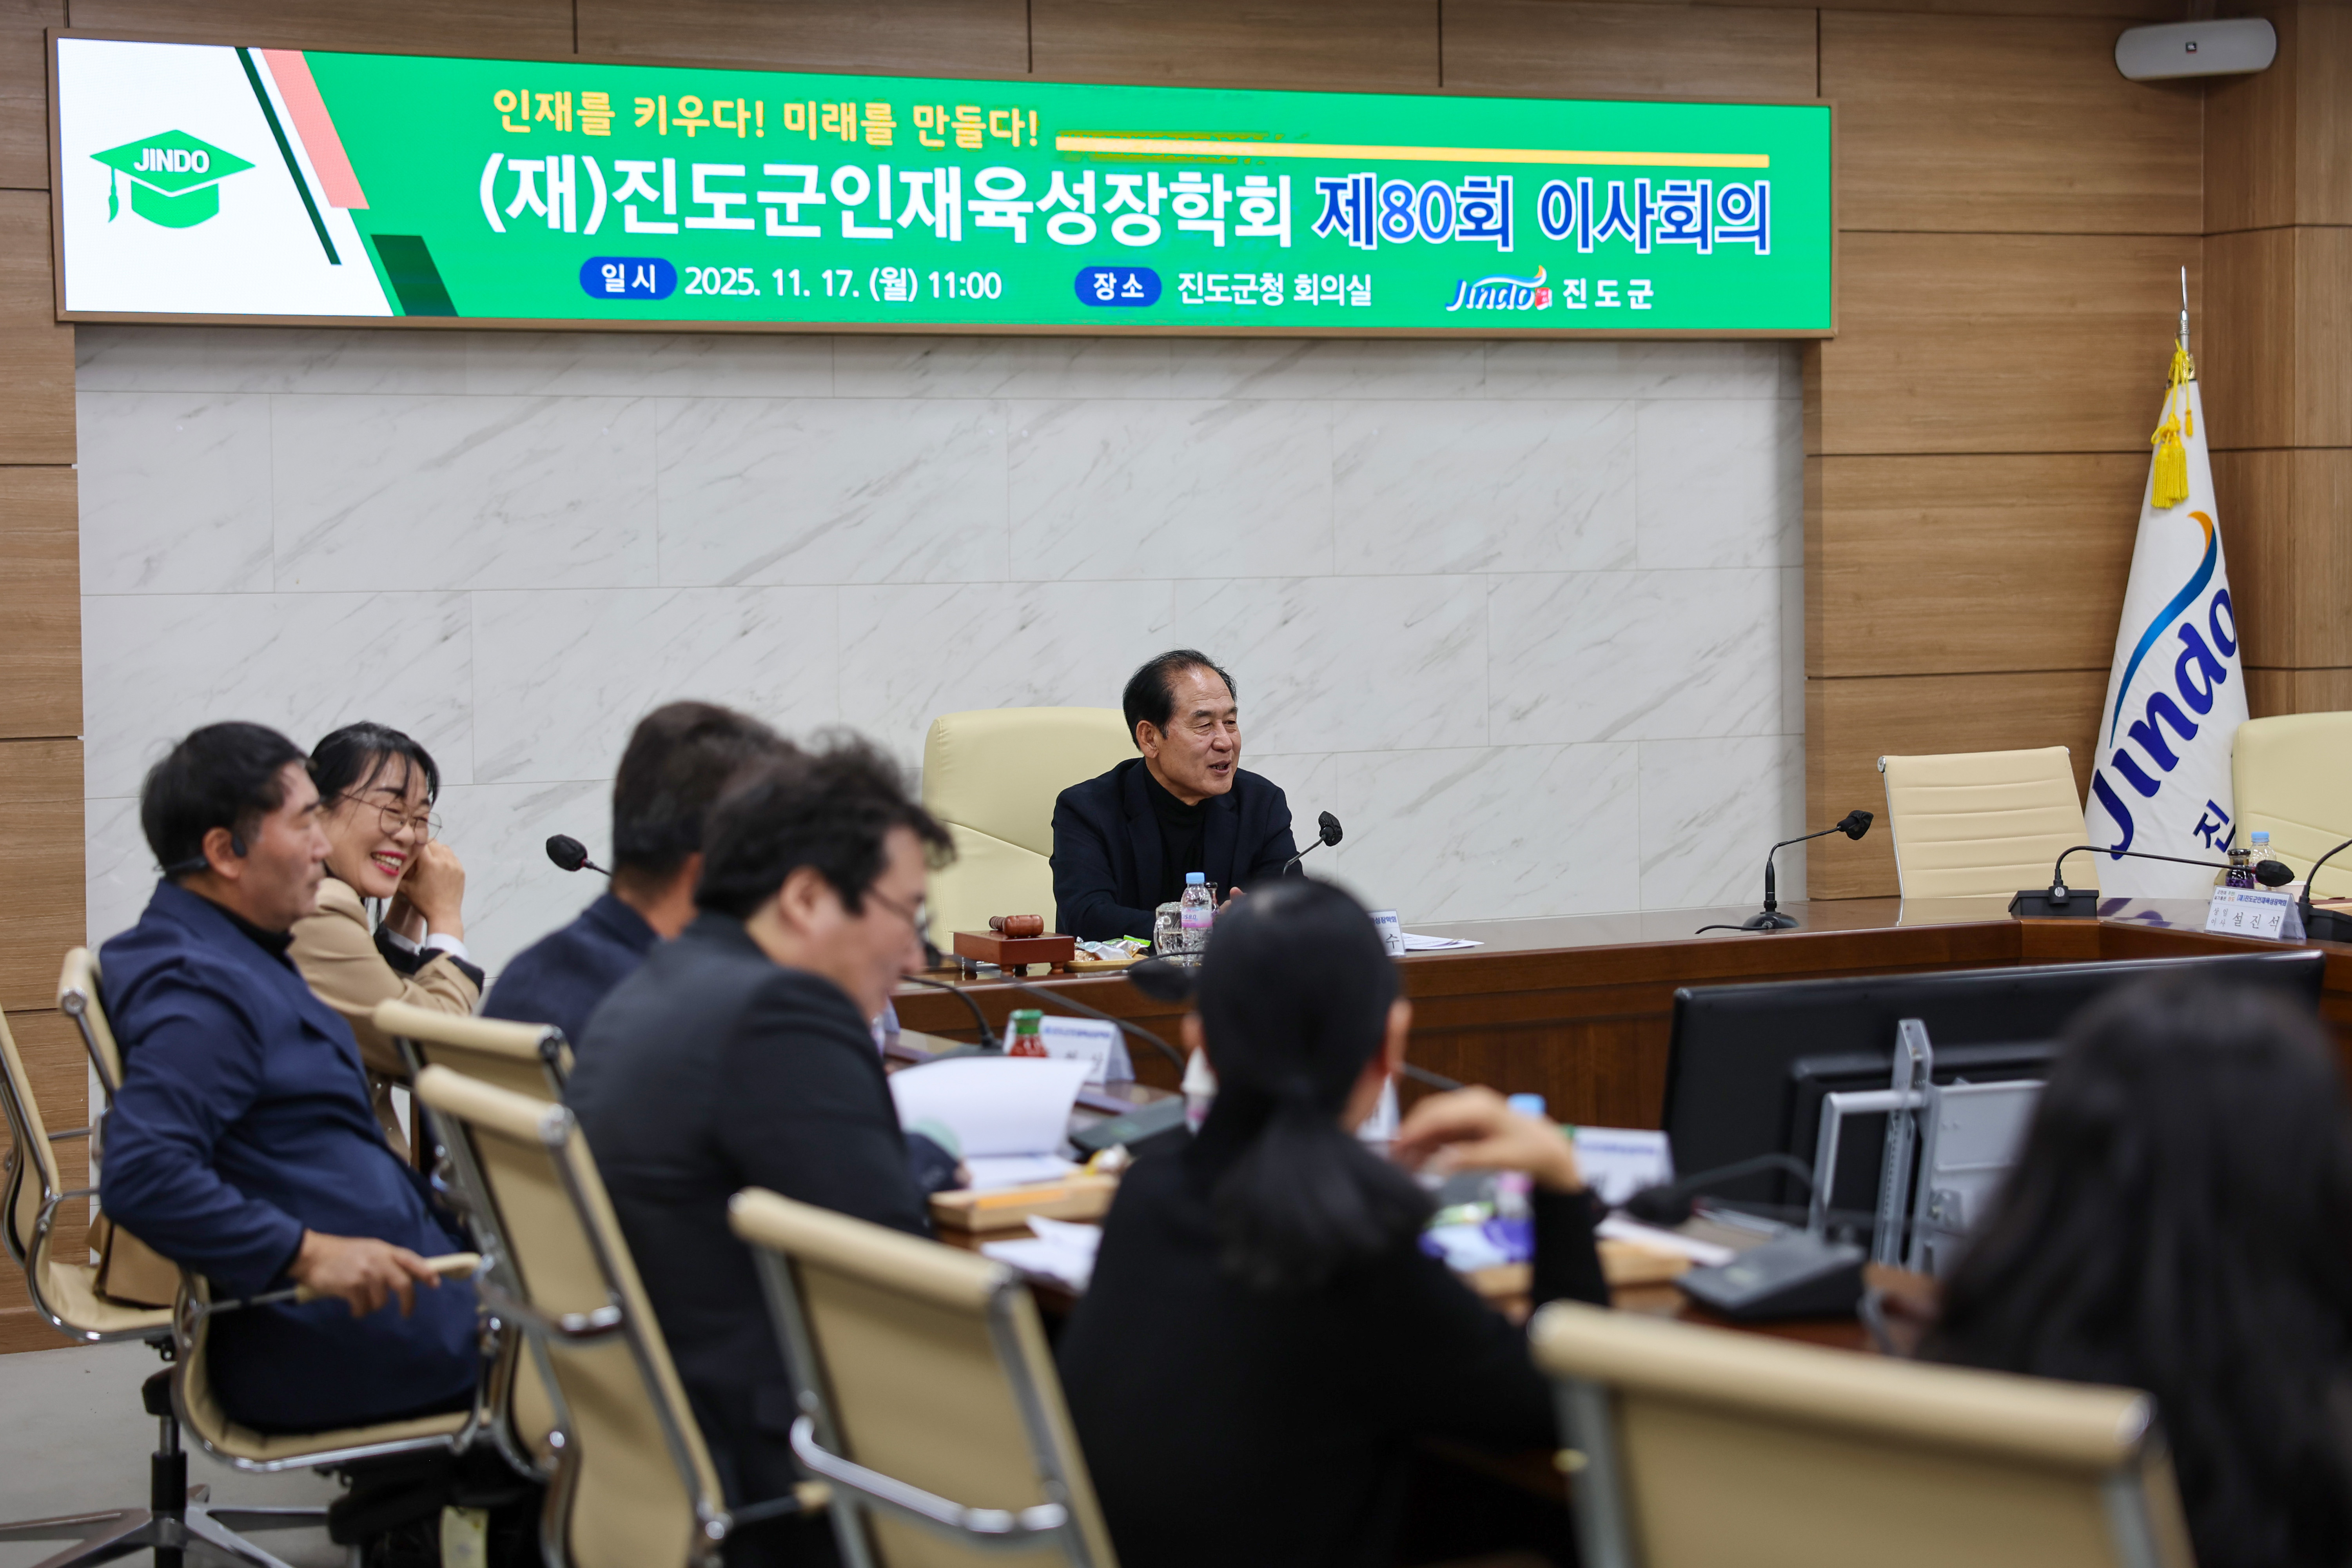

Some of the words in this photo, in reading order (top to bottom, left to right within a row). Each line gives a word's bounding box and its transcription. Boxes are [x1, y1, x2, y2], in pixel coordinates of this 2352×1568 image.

[494, 89, 615, 136] 인재를
[634, 96, 764, 138] 키우다!
[784, 101, 897, 146] 미래를
[913, 105, 1038, 149] 만들다!
[133, 148, 210, 173] JINDO
[480, 153, 1292, 247] (재)진도군인재육성장학회
[1311, 172, 1514, 252] 제80회
[1537, 177, 1770, 255] 이사회의
[601, 263, 655, 293] 일시
[685, 267, 761, 296] 2025.
[773, 269, 810, 297] 11.
[822, 269, 860, 298] 17.
[869, 267, 918, 302] (월)
[928, 271, 1002, 299] 11:00
[1094, 272, 1145, 301] 장소
[1178, 272, 1284, 306] 진도군청
[1293, 273, 1372, 306] 회의실
[1445, 279, 1537, 312] Jindo
[2092, 587, 2236, 860] Jindo
[2236, 894, 2287, 906] (재)진도군인재육성장학회
[1373, 916, 1397, 925] 성장학회
[1385, 933, 1400, 949] 수
